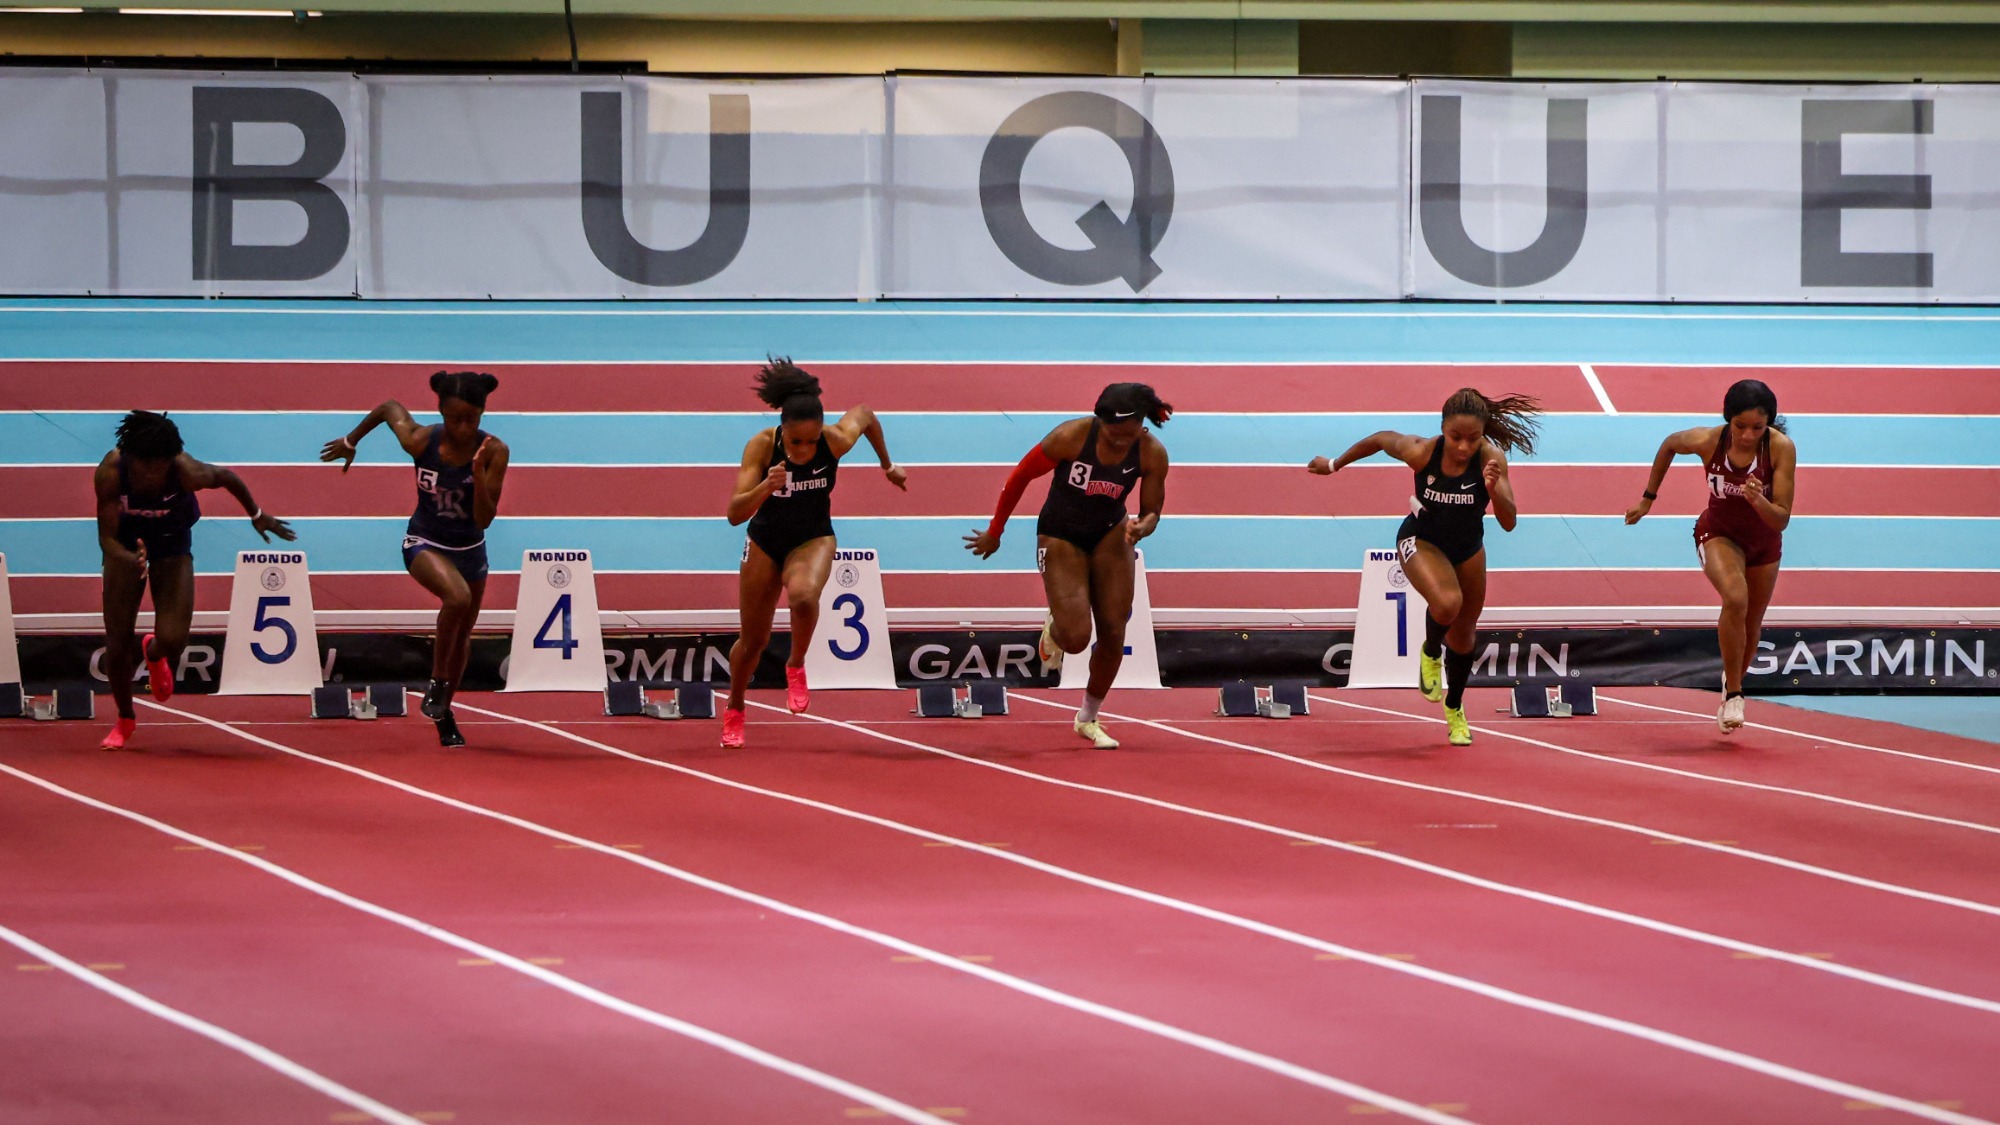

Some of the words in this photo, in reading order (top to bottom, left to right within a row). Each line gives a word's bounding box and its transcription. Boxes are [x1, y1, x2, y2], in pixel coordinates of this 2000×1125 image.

[420, 471, 433, 490] 5
[788, 477, 828, 492] ANFORD
[1071, 464, 1087, 486] 3
[1085, 480, 1124, 499] UNLV
[1423, 487, 1475, 505] STANFORD
[242, 553, 303, 564] MONDO
[529, 552, 587, 562] MONDO
[833, 551, 875, 561] ONDO
[250, 596, 297, 664] 5
[533, 594, 578, 659] 4
[828, 593, 869, 660] 3
[1385, 592, 1407, 656] 1
[1322, 642, 1568, 677] GMIN
[1747, 638, 1985, 677] GARMIN
